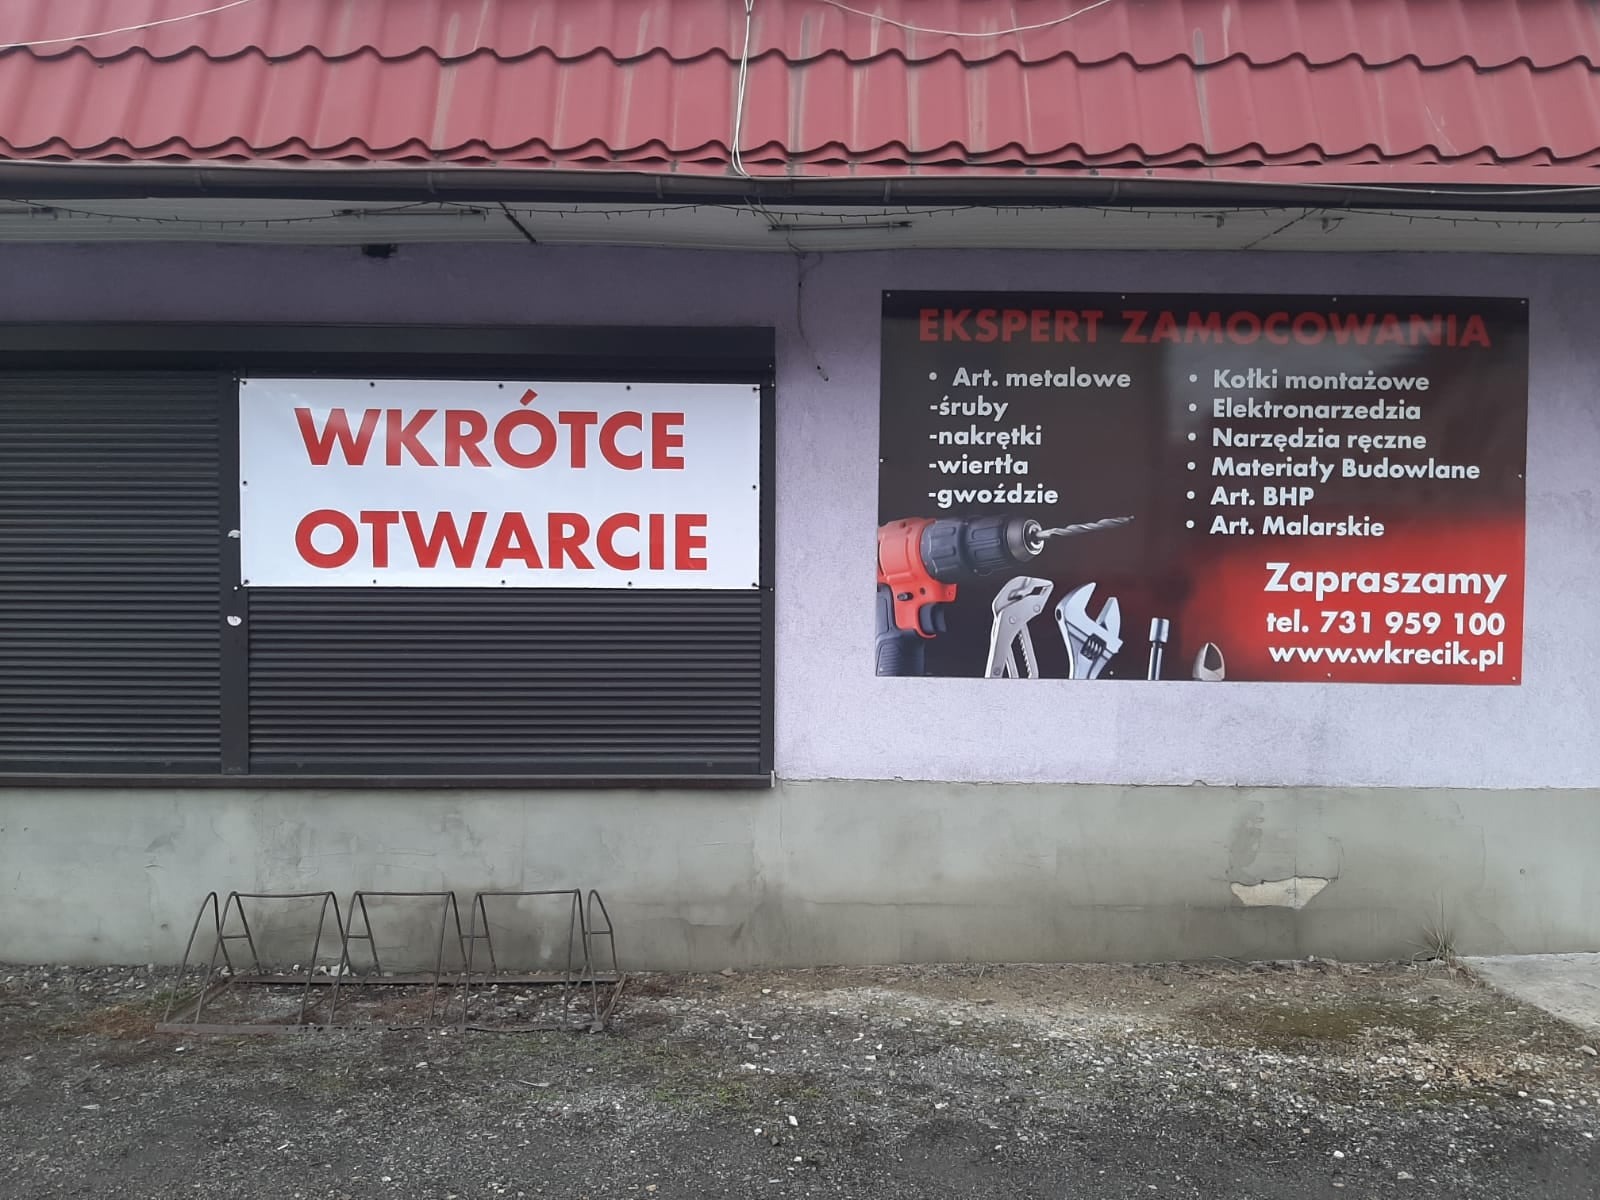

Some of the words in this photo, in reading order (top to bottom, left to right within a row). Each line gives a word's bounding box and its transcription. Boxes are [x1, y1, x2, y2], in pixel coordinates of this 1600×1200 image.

[919, 308, 1104, 343] EKSPERT
[1120, 311, 1492, 347] ZAMOCOWANIA
[952, 367, 999, 387] Art.
[1006, 366, 1131, 388] metalowe
[1213, 368, 1278, 389] Kołki
[1285, 370, 1430, 391] montażowe
[930, 395, 1008, 422] -śruby
[1213, 398, 1421, 420] Elektronarzedzia
[294, 388, 685, 470] WKRÓTCE
[929, 425, 1041, 449] -nakrętki
[1212, 427, 1340, 452] Narzędzia
[1348, 432, 1427, 452] ręczne
[929, 454, 1028, 475] -wiertła
[1212, 456, 1335, 483] Materiały
[1342, 458, 1480, 479] Budowlane
[928, 483, 1058, 508] -gwoździe
[1210, 486, 1255, 506] Art.
[1263, 487, 1314, 506] BHP
[1210, 515, 1254, 535] Art.
[1262, 515, 1384, 536] Malarskie
[294, 508, 708, 571] OTWARCIE
[1264, 562, 1507, 604] Zapraszamy
[1266, 609, 1309, 633] tel.
[1320, 611, 1371, 634] 731
[1385, 612, 1441, 635] 959
[1454, 612, 1505, 636] 100
[1268, 640, 1504, 672] www.wkrecik.pl
